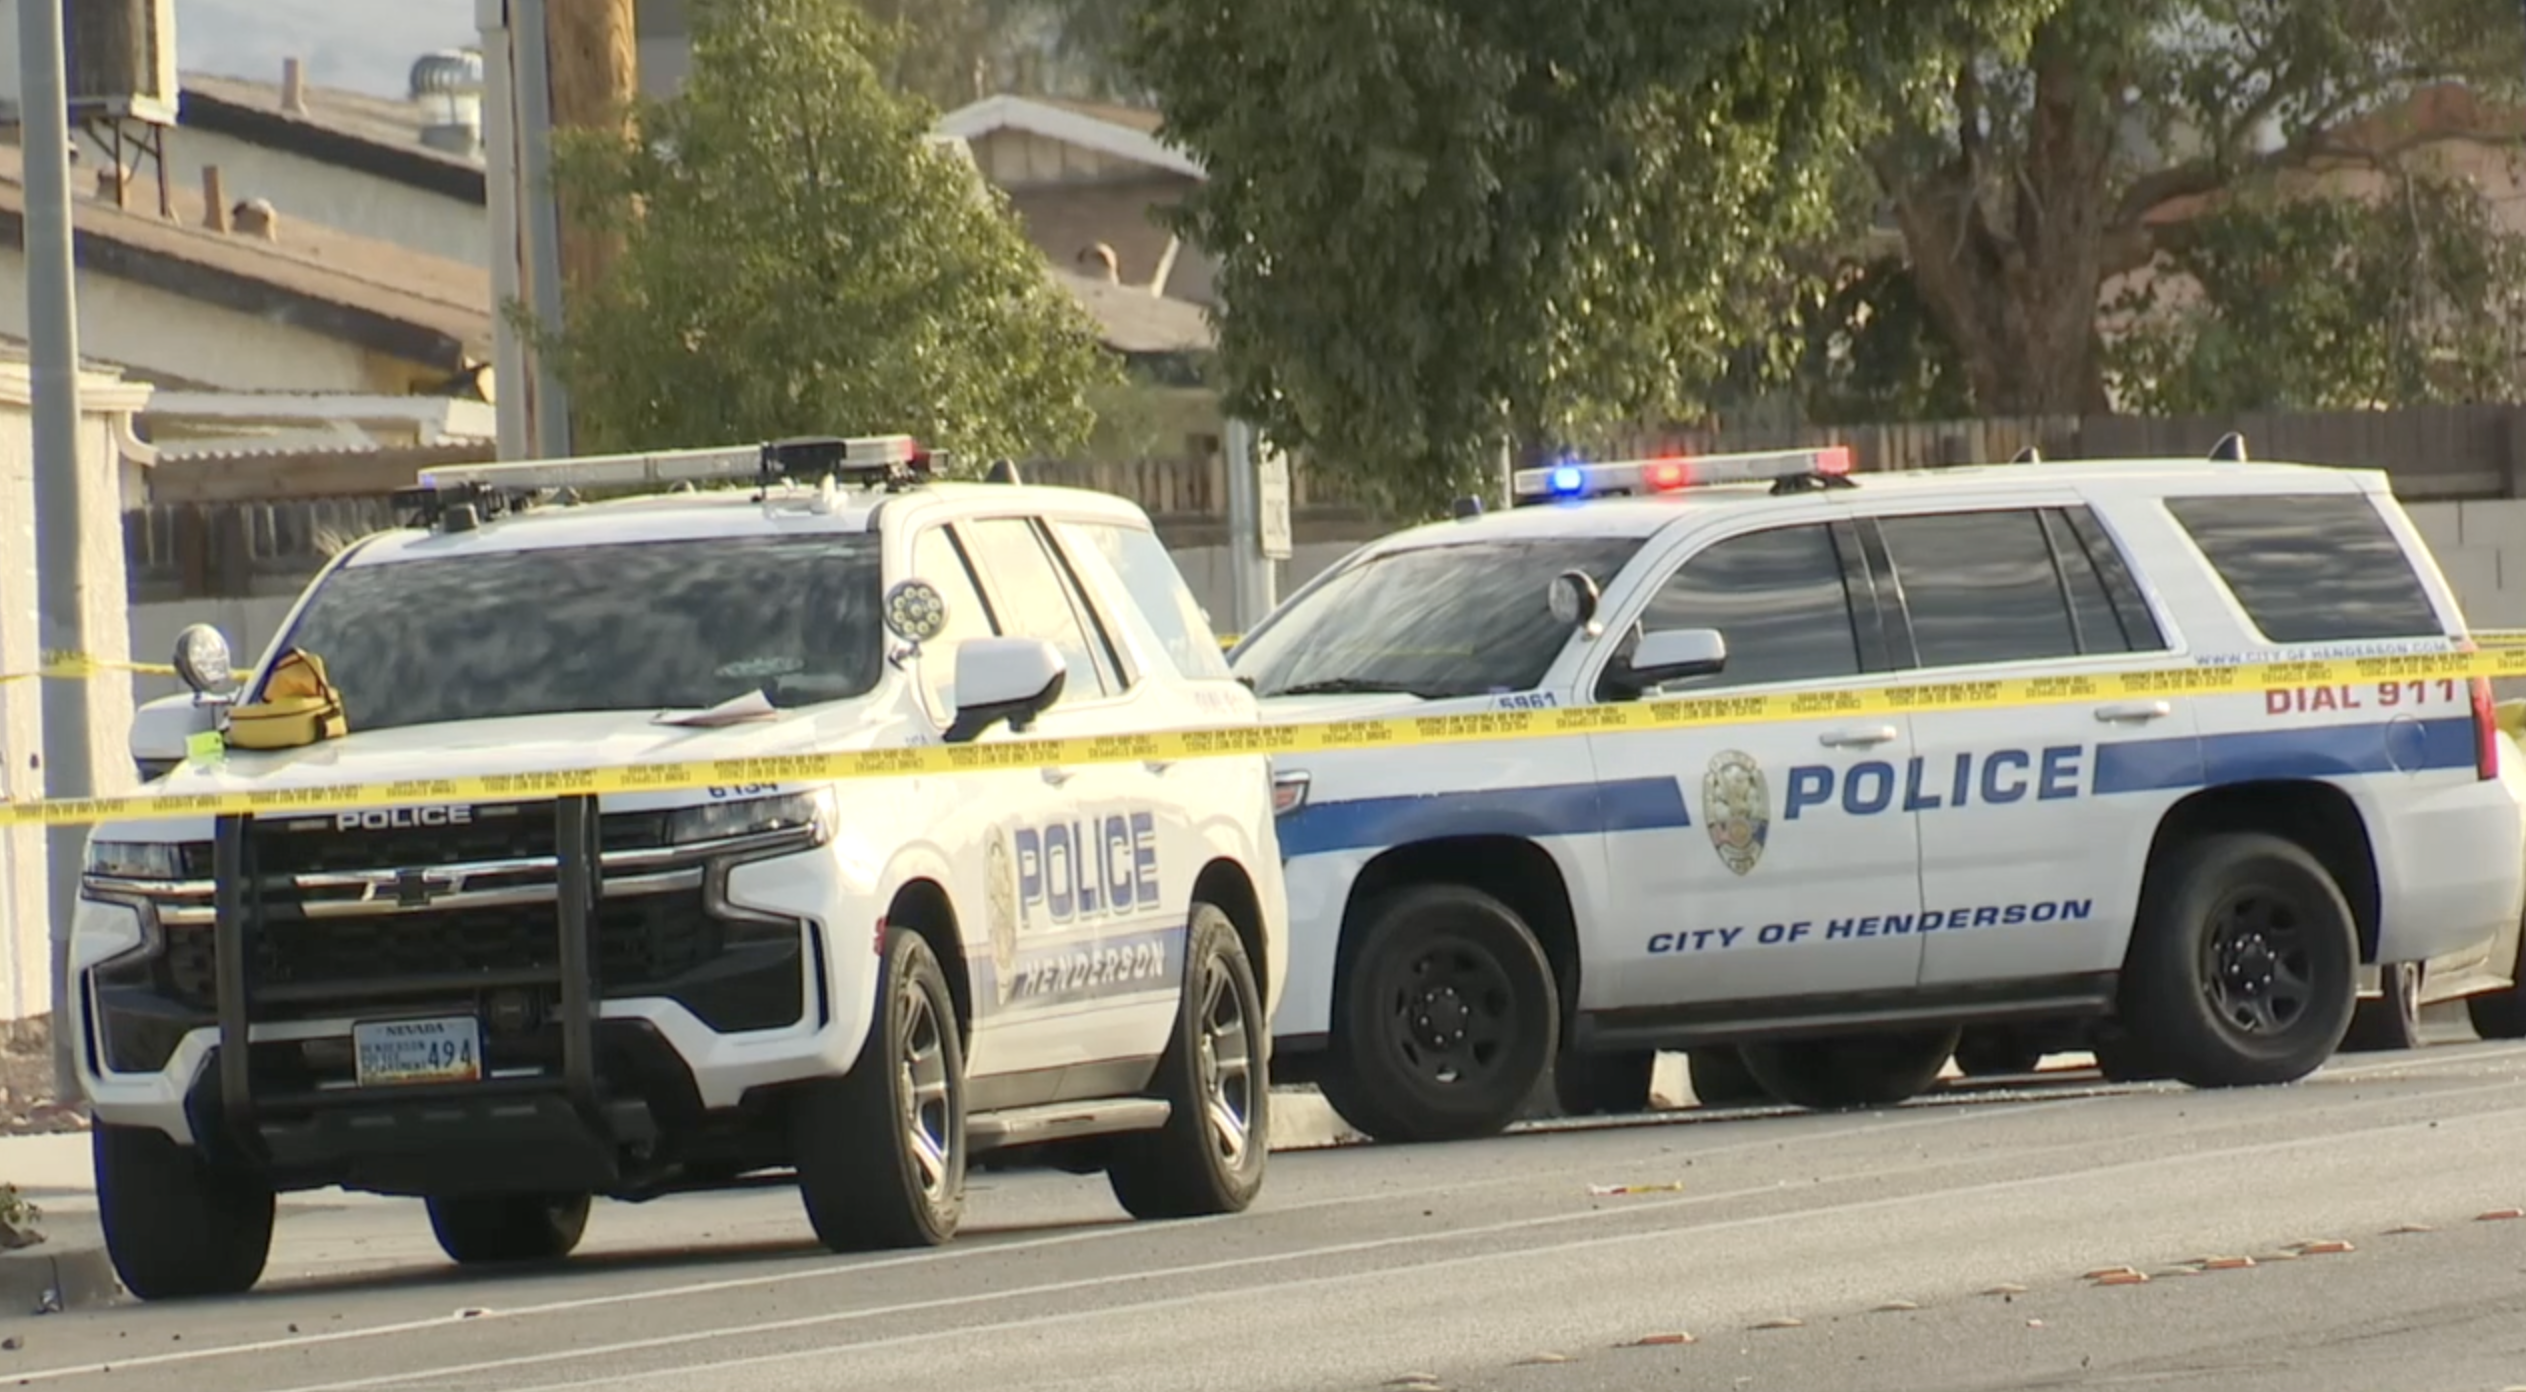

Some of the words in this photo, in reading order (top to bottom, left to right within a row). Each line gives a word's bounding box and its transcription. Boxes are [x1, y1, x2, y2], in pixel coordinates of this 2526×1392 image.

[2266, 684, 2361, 715] DIAL
[2378, 677, 2454, 706] 911
[1783, 745, 2084, 821] POLICE
[336, 804, 473, 832] POLICE
[1014, 811, 1161, 930] POLICE
[1647, 927, 1743, 954] CITY
[1757, 921, 1812, 947] OF
[1826, 899, 2092, 940] HENDERSON
[1021, 939, 1165, 997] HENDERSON
[386, 1022, 445, 1036] NEVADA
[427, 1038, 472, 1069] 494
